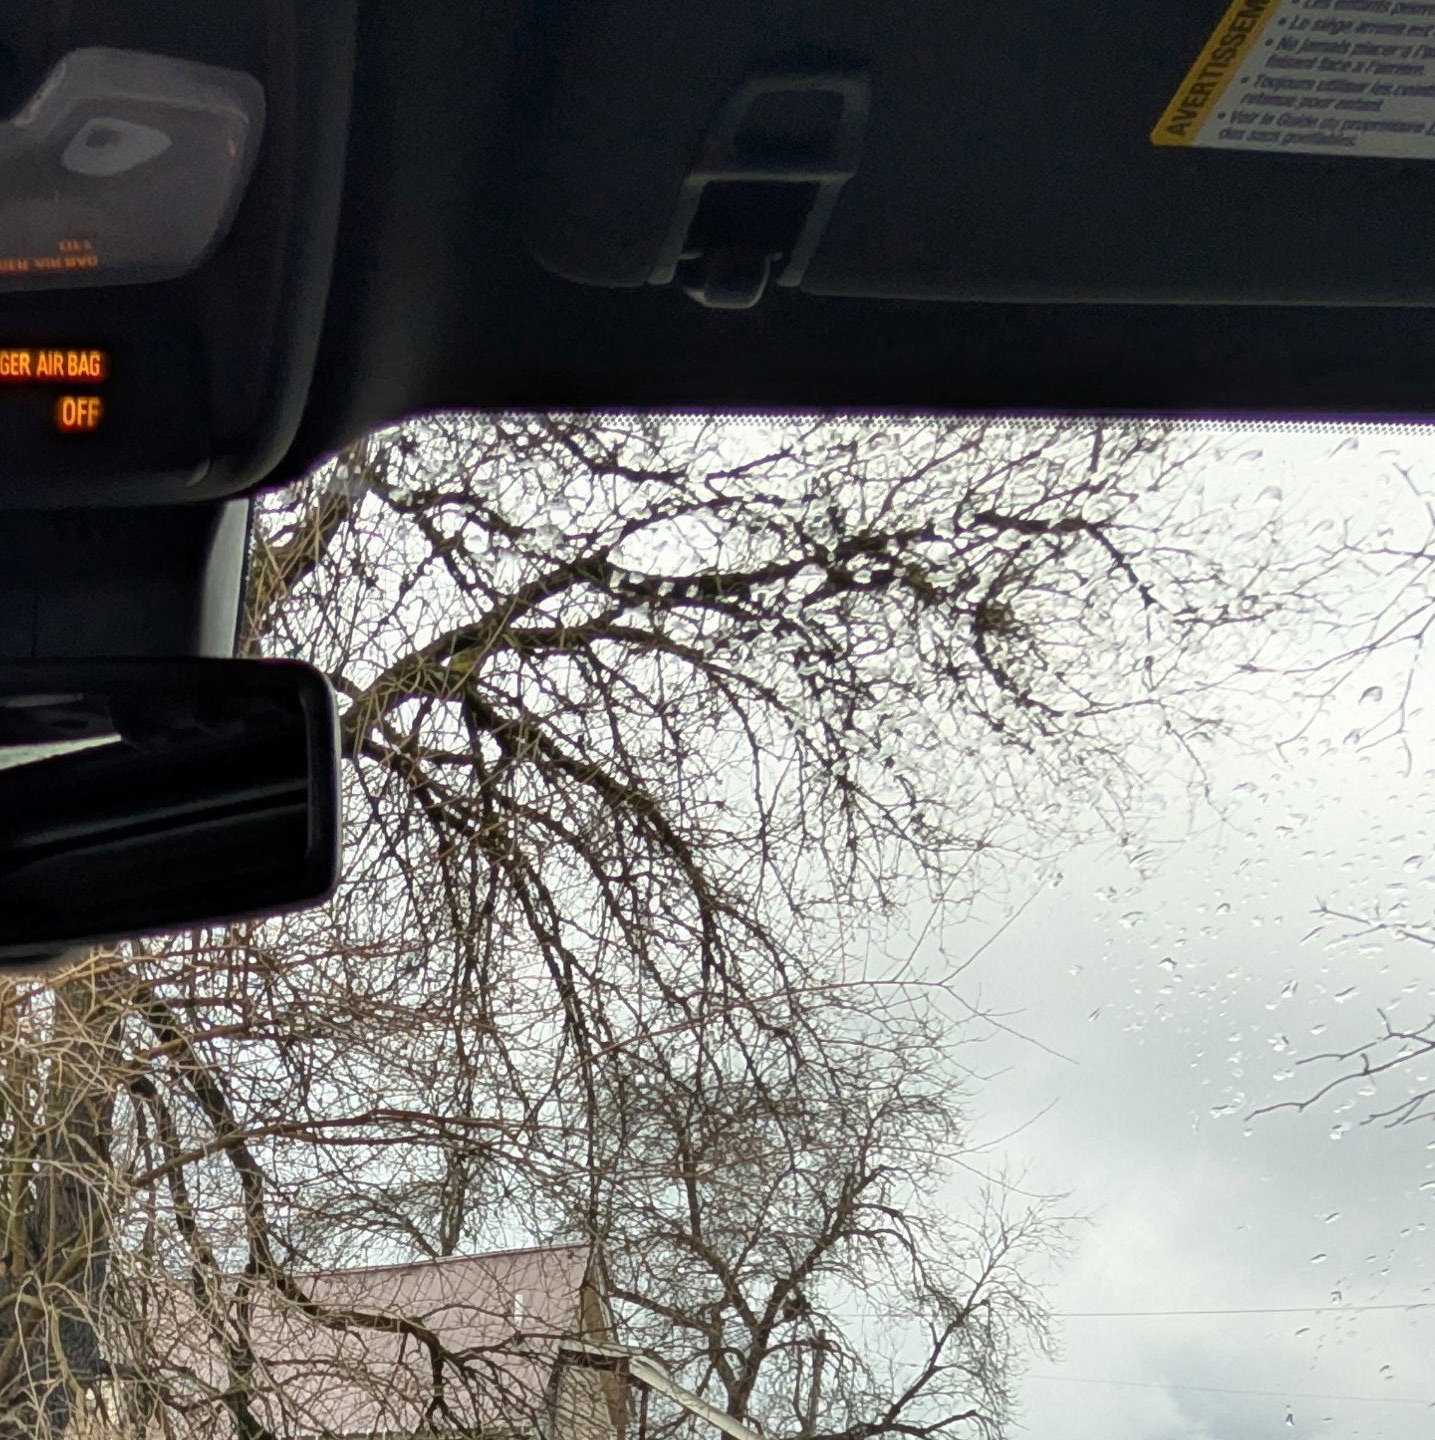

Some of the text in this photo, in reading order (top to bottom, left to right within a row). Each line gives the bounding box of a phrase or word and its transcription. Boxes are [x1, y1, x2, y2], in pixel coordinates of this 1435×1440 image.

[36, 350, 64, 377] AIR
[67, 350, 101, 377] BAG
[62, 397, 100, 426] OFF
